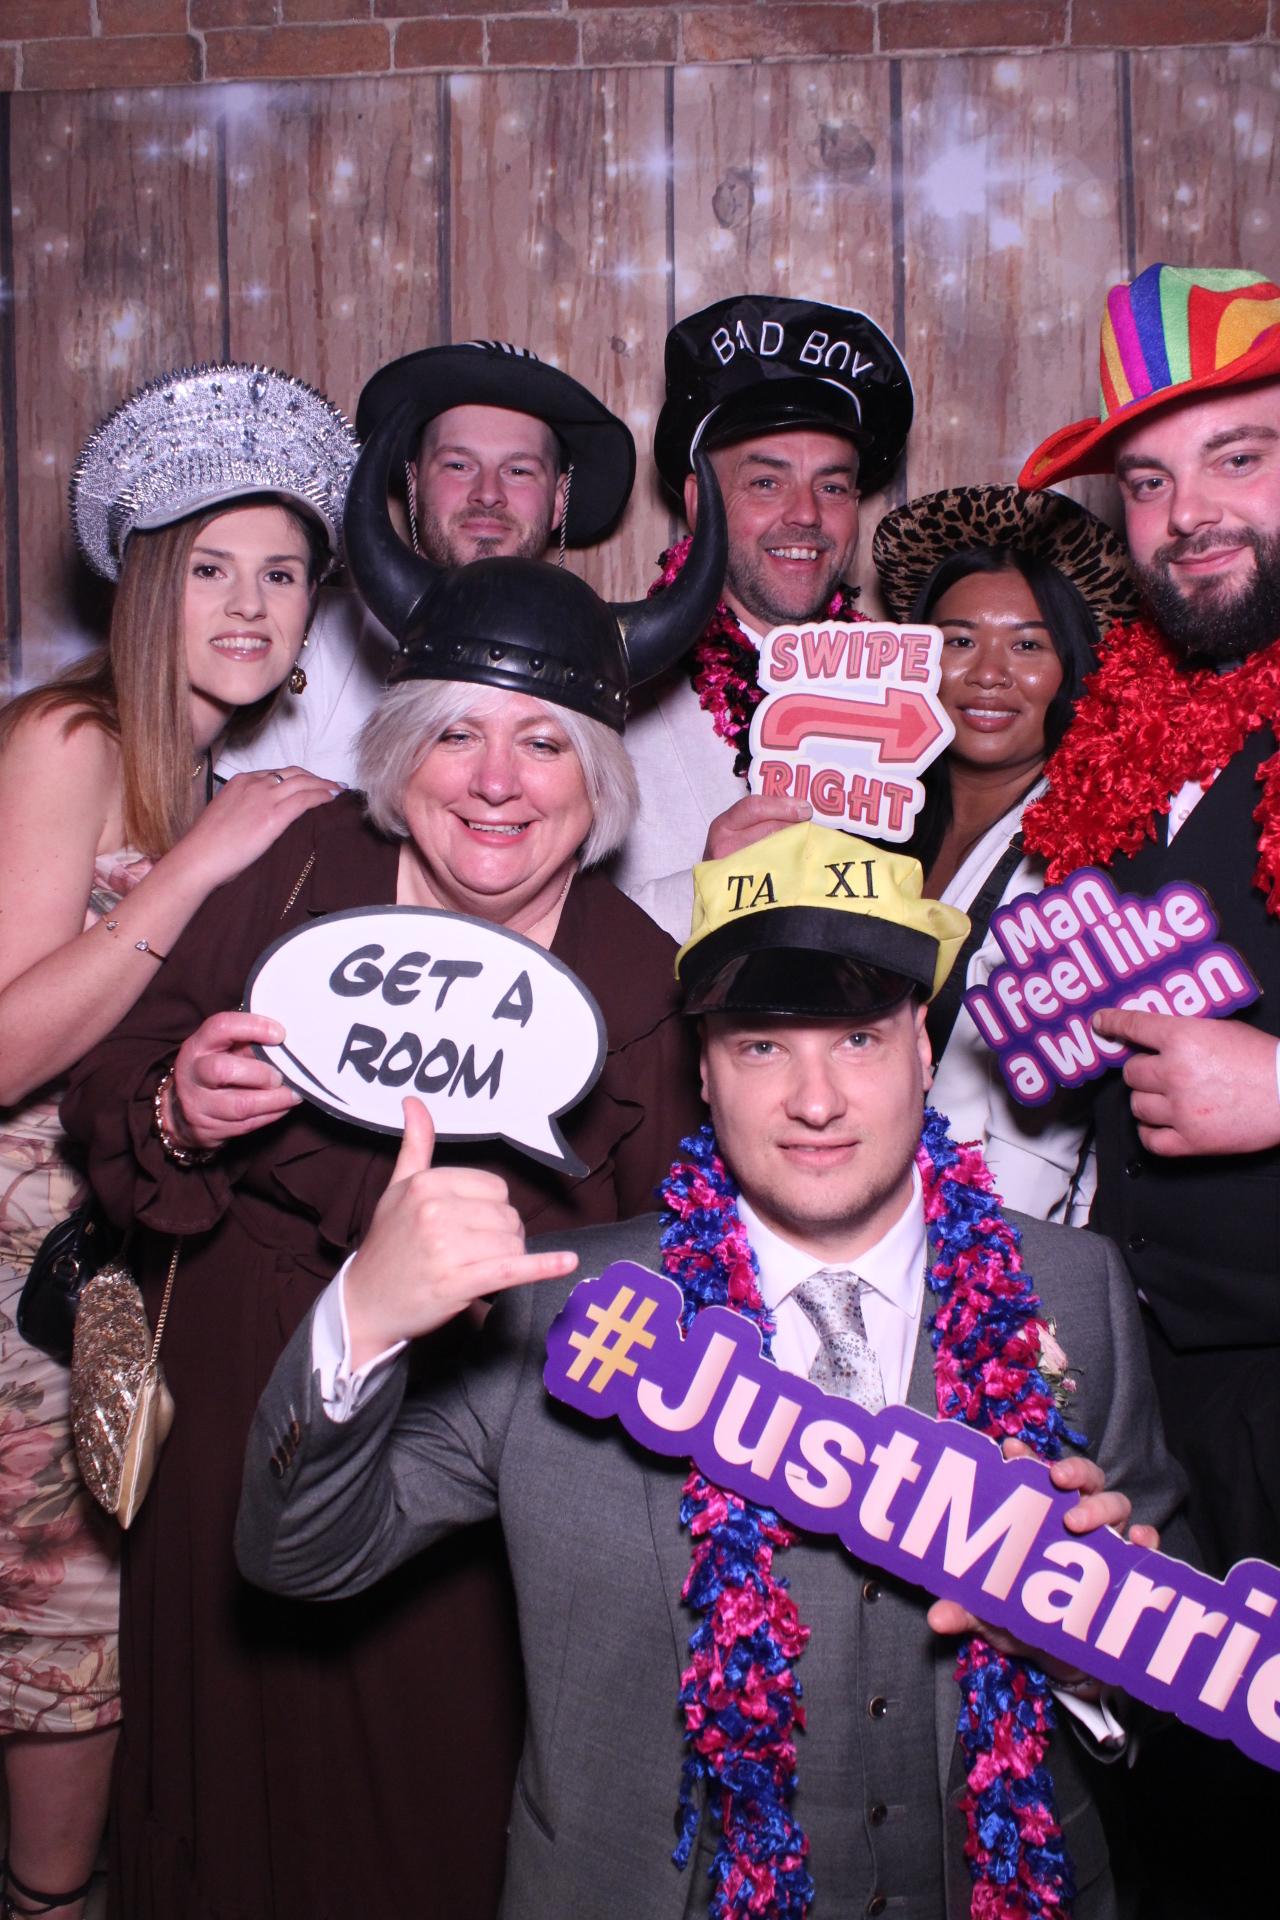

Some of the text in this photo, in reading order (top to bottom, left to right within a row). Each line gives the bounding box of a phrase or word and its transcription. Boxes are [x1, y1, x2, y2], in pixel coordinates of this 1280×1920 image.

[711, 319, 785, 366] BAD
[769, 630, 932, 683] SWIPE
[759, 760, 914, 832] RIGHT
[999, 879, 1115, 966] Man
[328, 943, 534, 1029] GET A
[972, 894, 1206, 1042] I feel like
[337, 1022, 504, 1100] ROOM
[1008, 1055, 1046, 1095] a
